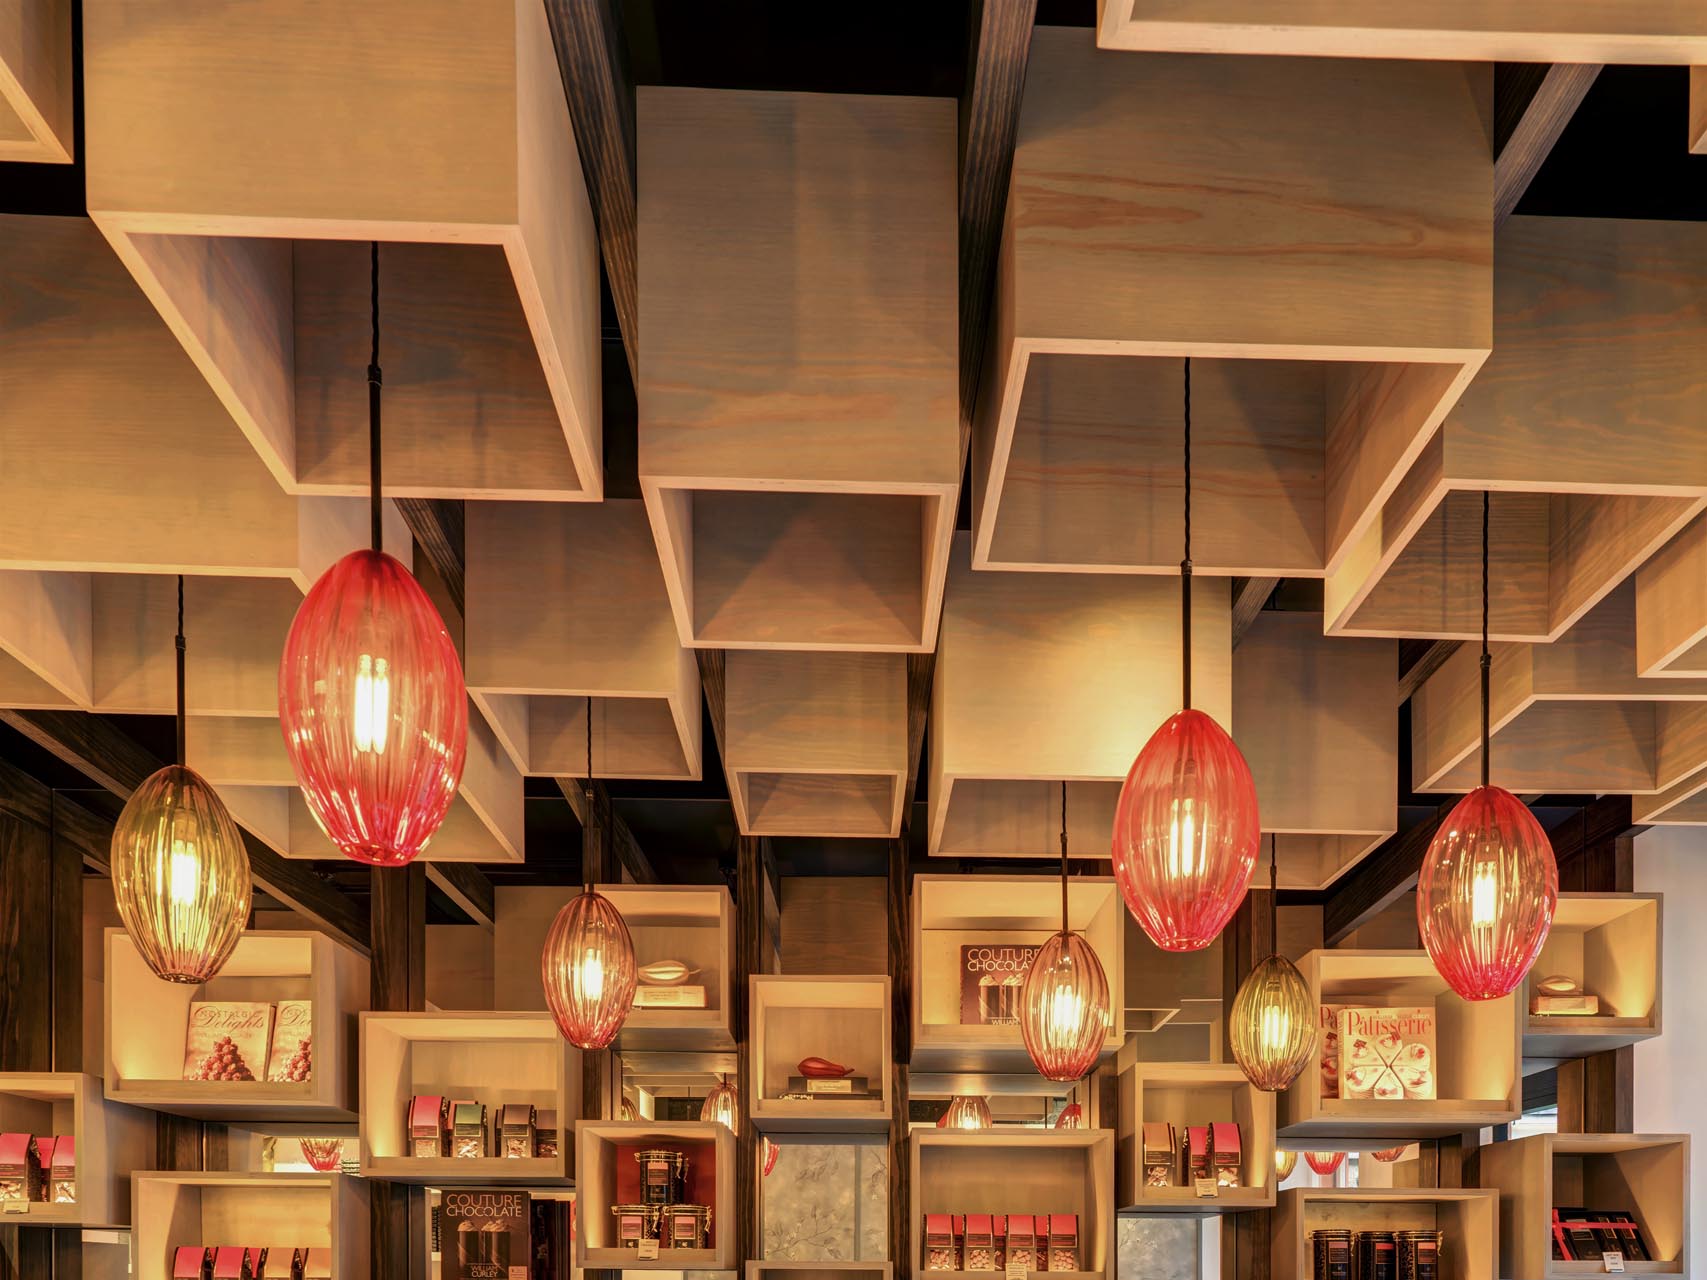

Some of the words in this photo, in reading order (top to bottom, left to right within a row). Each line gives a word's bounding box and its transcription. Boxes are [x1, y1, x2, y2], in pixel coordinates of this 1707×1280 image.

[967, 960, 1033, 972] CHOCOLA
[193, 1006, 264, 1033] Delights
[446, 1194, 522, 1207] COUTURE
[446, 1206, 522, 1217] CHOCOLATE
[471, 1270, 498, 1278] CURLEY
